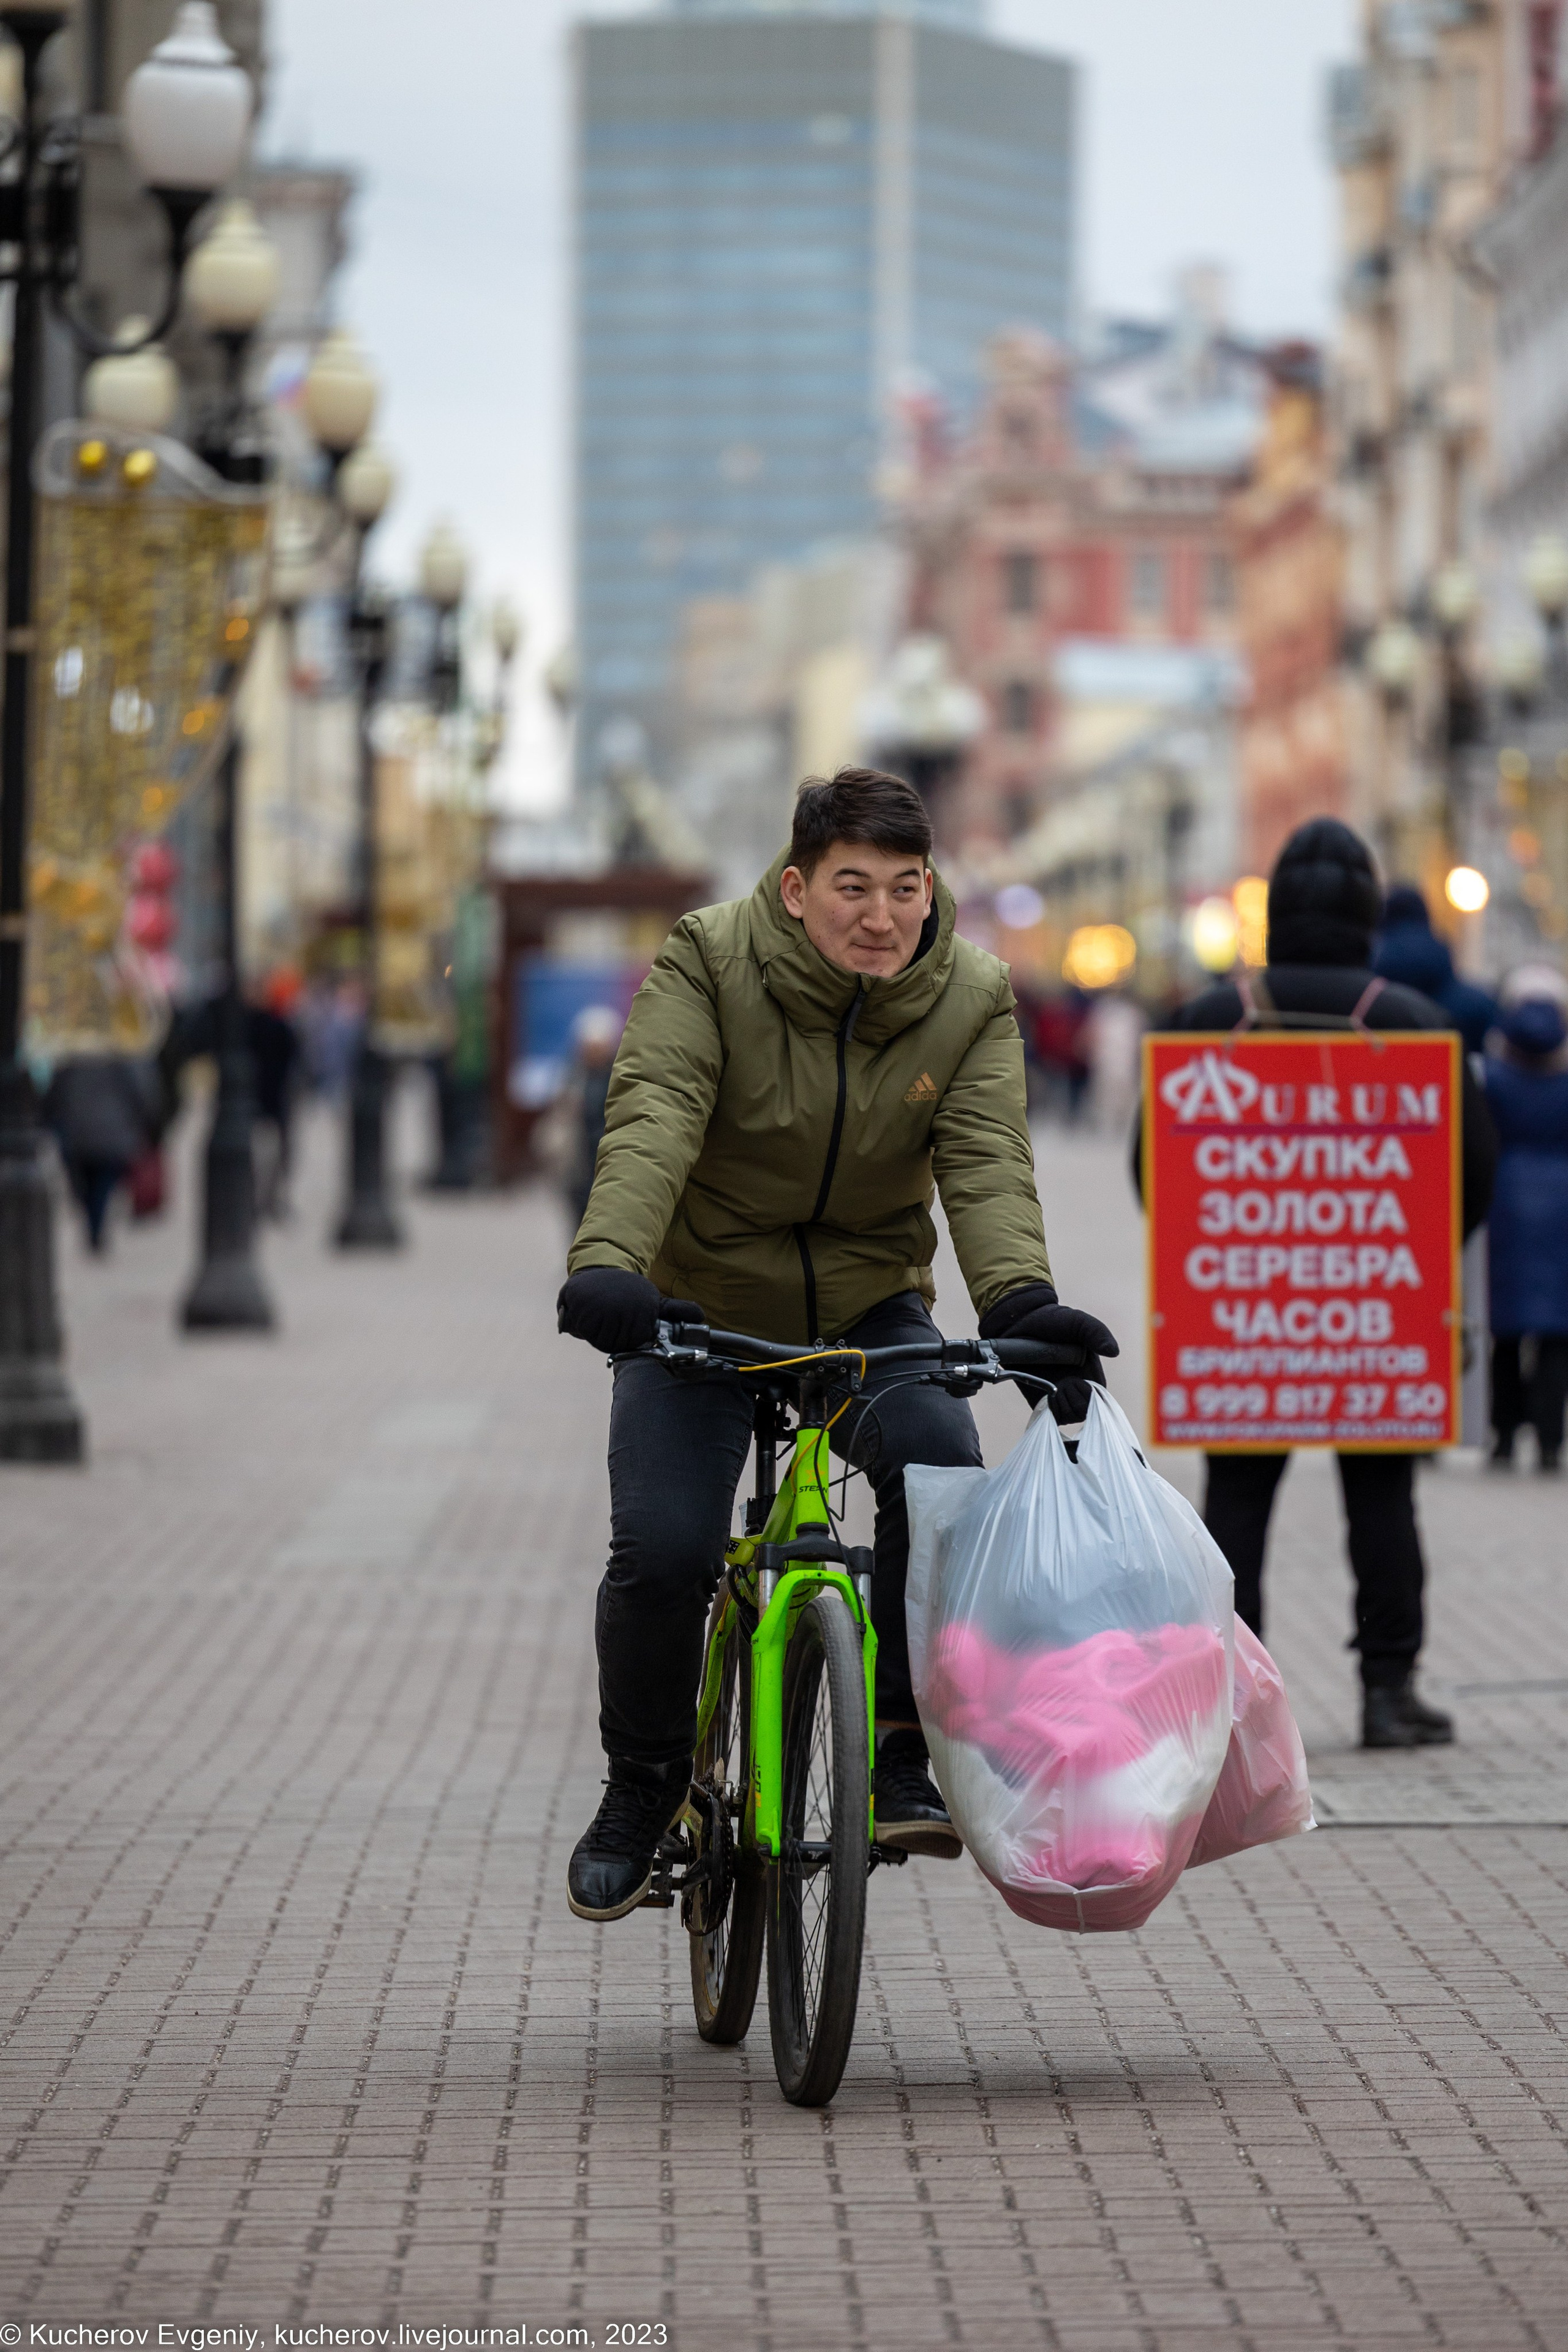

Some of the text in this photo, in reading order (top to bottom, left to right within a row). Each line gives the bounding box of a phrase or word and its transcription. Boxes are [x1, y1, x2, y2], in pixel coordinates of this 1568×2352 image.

[1195, 1136, 1411, 1180] СКУПКА
[1200, 1190, 1407, 1234] ЗОЛОТА
[1185, 1245, 1421, 1289] СЕРЕБРА
[1213, 1299, 1393, 1343] ЧАСОВ
[1178, 1348, 1428, 1376] БРИЛЛИАНТОВ
[1162, 1385, 1446, 1418] 8 999 817 37 50
